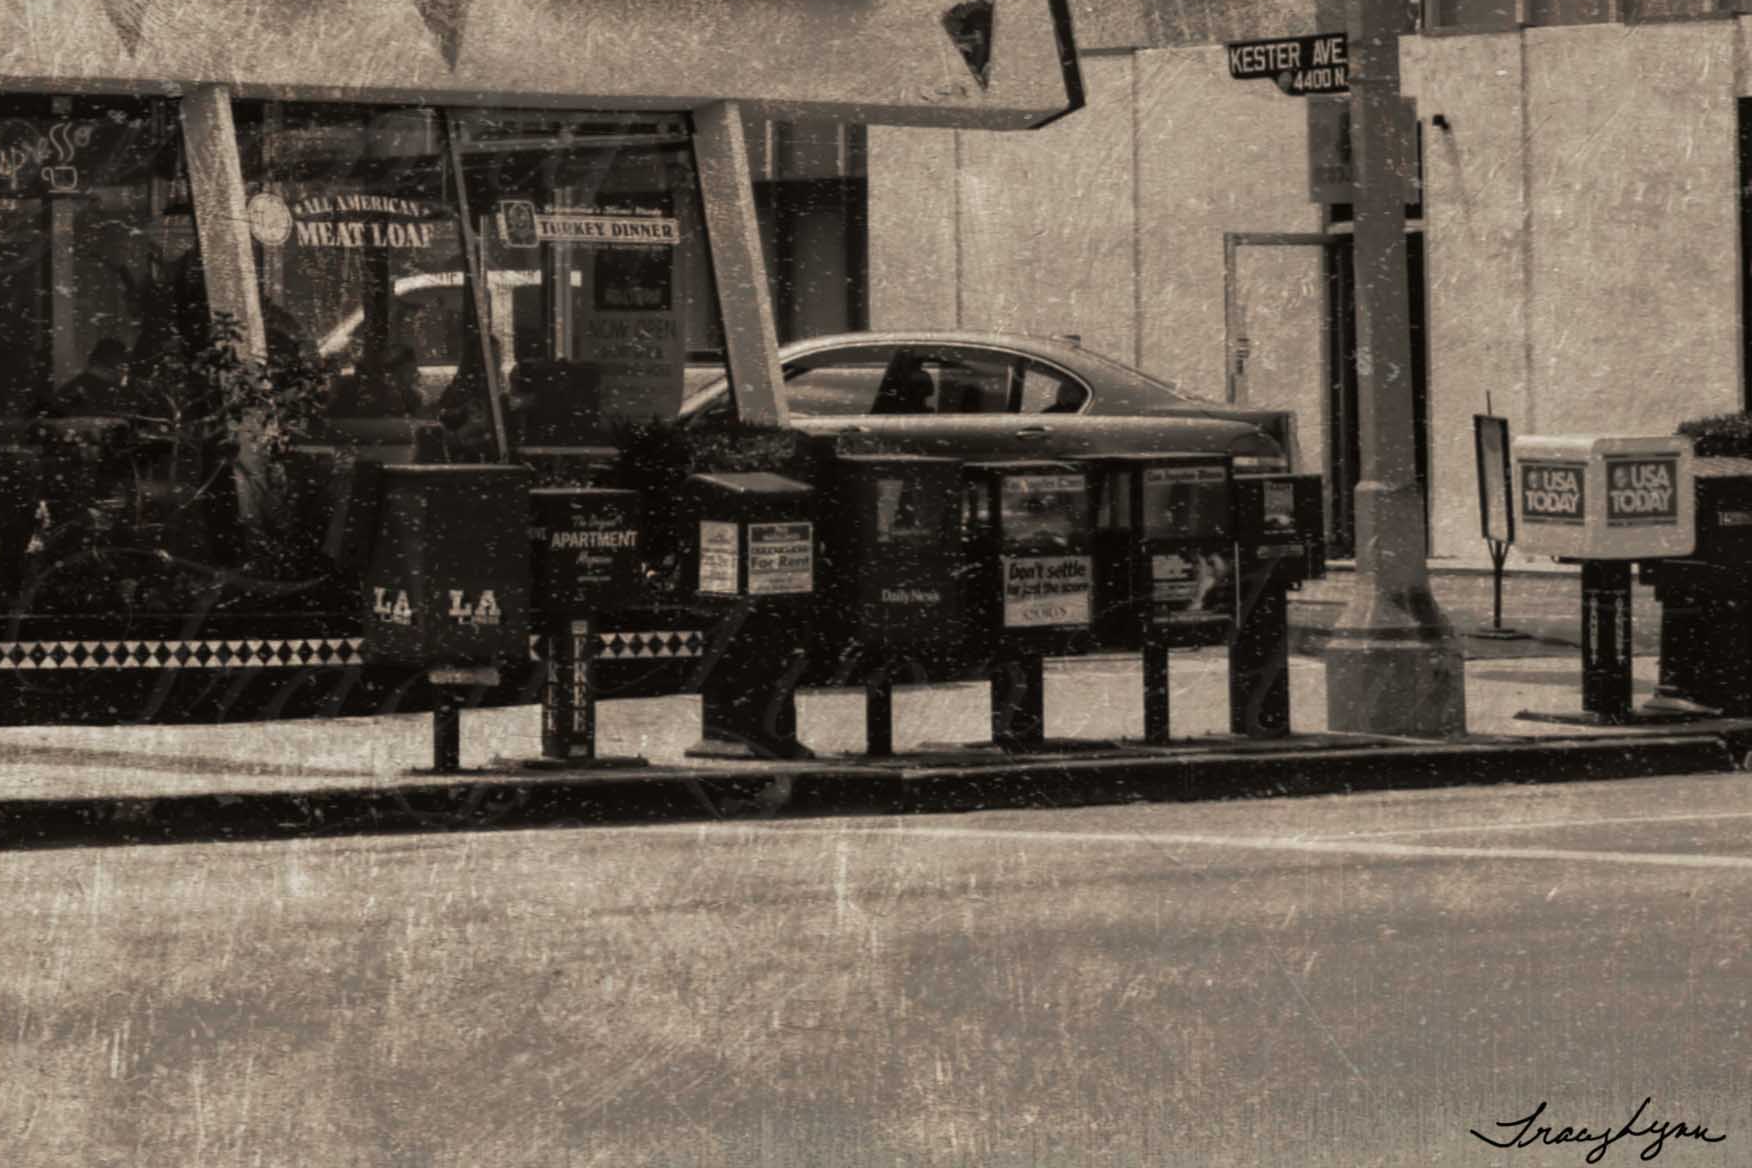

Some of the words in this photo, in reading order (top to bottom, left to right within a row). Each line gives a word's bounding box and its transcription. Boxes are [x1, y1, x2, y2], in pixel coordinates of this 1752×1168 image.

[1229, 42, 1301, 75] KESTER
[1293, 68, 1332, 90] 4400
[301, 199, 333, 216] ALL
[335, 194, 424, 216] AMERICAN
[295, 221, 366, 248] MEAT
[372, 222, 435, 248] LOAF
[541, 221, 605, 237] TURKEY
[611, 223, 673, 239] DINNER
[1544, 471, 1578, 492] USA
[1630, 464, 1670, 485] USA
[1525, 490, 1580, 514] TODAY
[1610, 488, 1673, 514] TODAY
[551, 531, 639, 548] APARTMENT
[1008, 560, 1044, 580] Don't
[1047, 558, 1087, 578] settle
[373, 586, 413, 617] LA
[448, 589, 502, 617] LA
[881, 588, 910, 606] Daily
